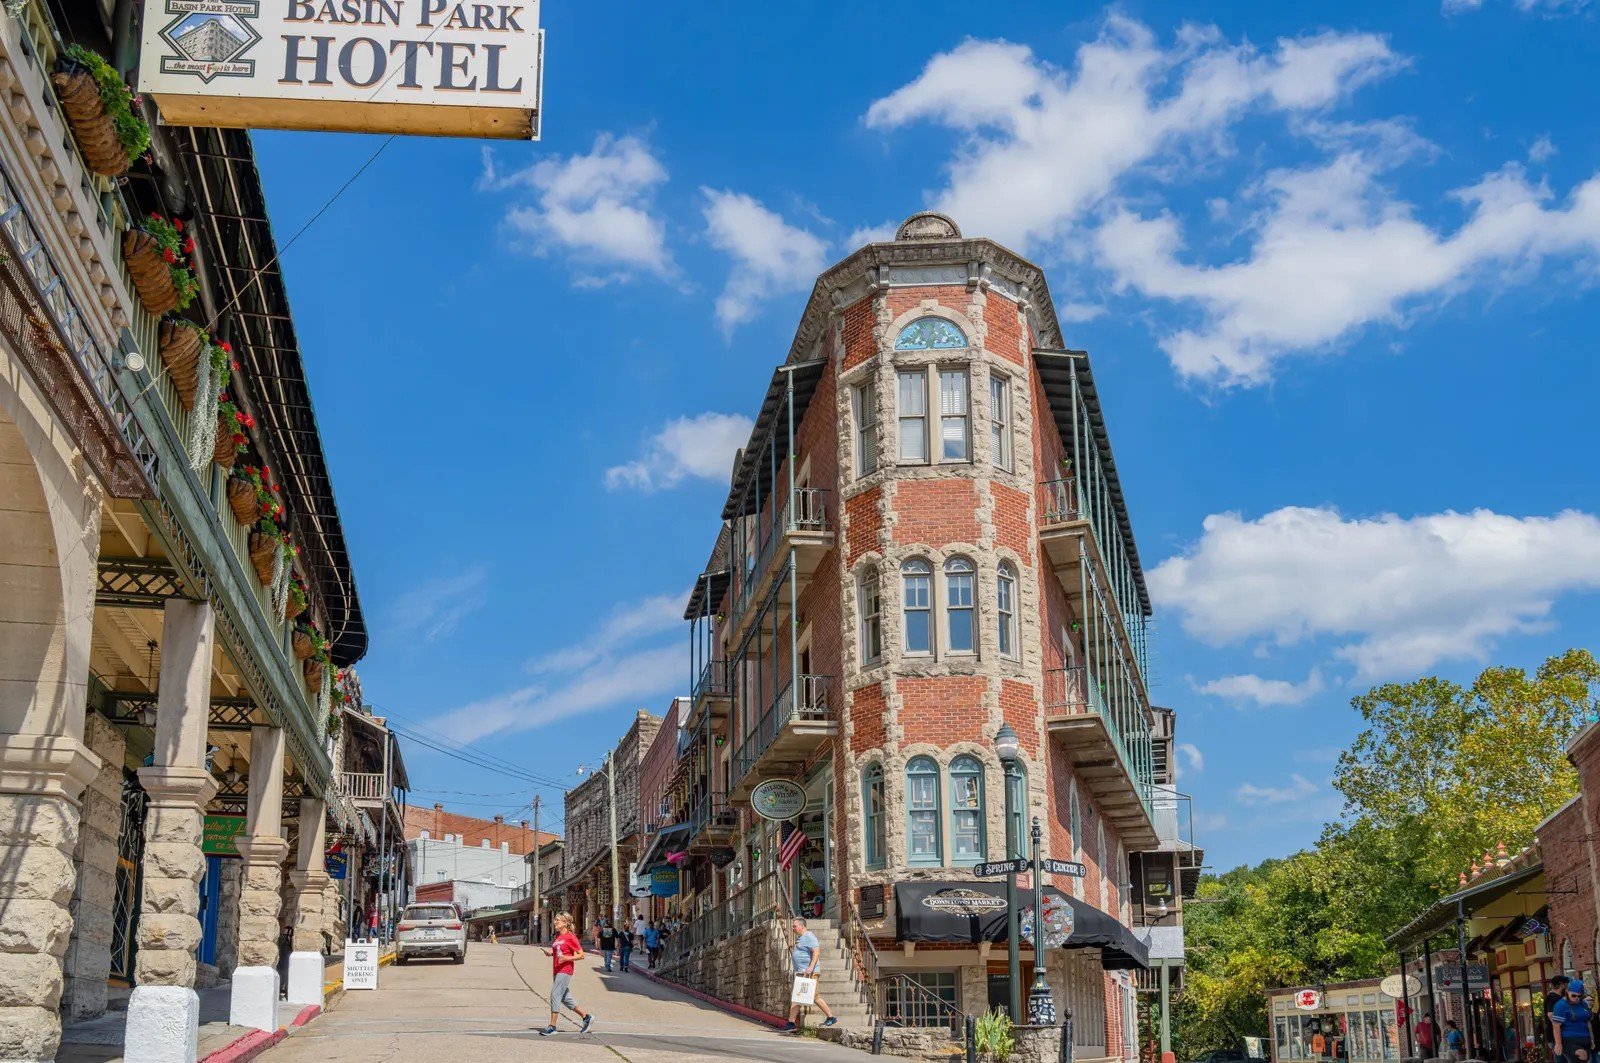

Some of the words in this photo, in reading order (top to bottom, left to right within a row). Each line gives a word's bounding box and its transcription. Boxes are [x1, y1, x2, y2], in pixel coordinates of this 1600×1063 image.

[171, 2, 198, 11] BASIN
[200, 3, 223, 12] PARK
[225, 5, 253, 14] HOTEL
[283, 0, 404, 27] BASIN
[416, 0, 524, 32] PARK
[278, 35, 522, 93] HOTEL
[760, 783, 785, 794] WILSON
[203, 820, 232, 831] ailor's
[332, 854, 346, 864] ONE
[985, 862, 1016, 878] SPRING
[1052, 862, 1079, 875] CENTER
[929, 899, 971, 907] DOWNTOWN
[971, 899, 1001, 907] MARKET
